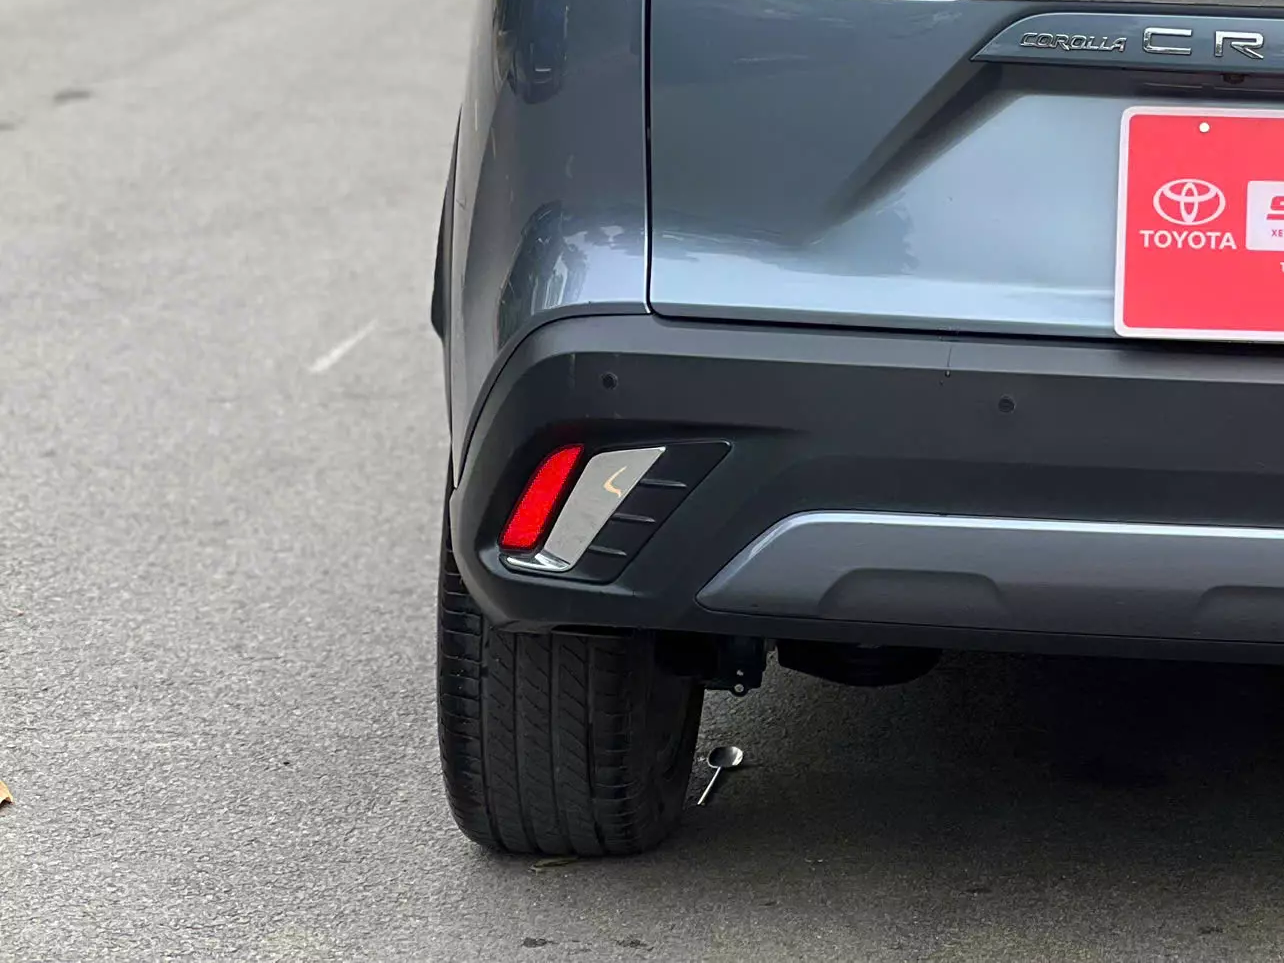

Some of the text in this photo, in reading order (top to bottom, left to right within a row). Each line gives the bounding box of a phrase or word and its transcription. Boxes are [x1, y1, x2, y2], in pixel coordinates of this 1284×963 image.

[1020, 31, 1127, 52] COROLLA
[1140, 229, 1237, 250] TOYOTA
[1271, 229, 1284, 238] XE
